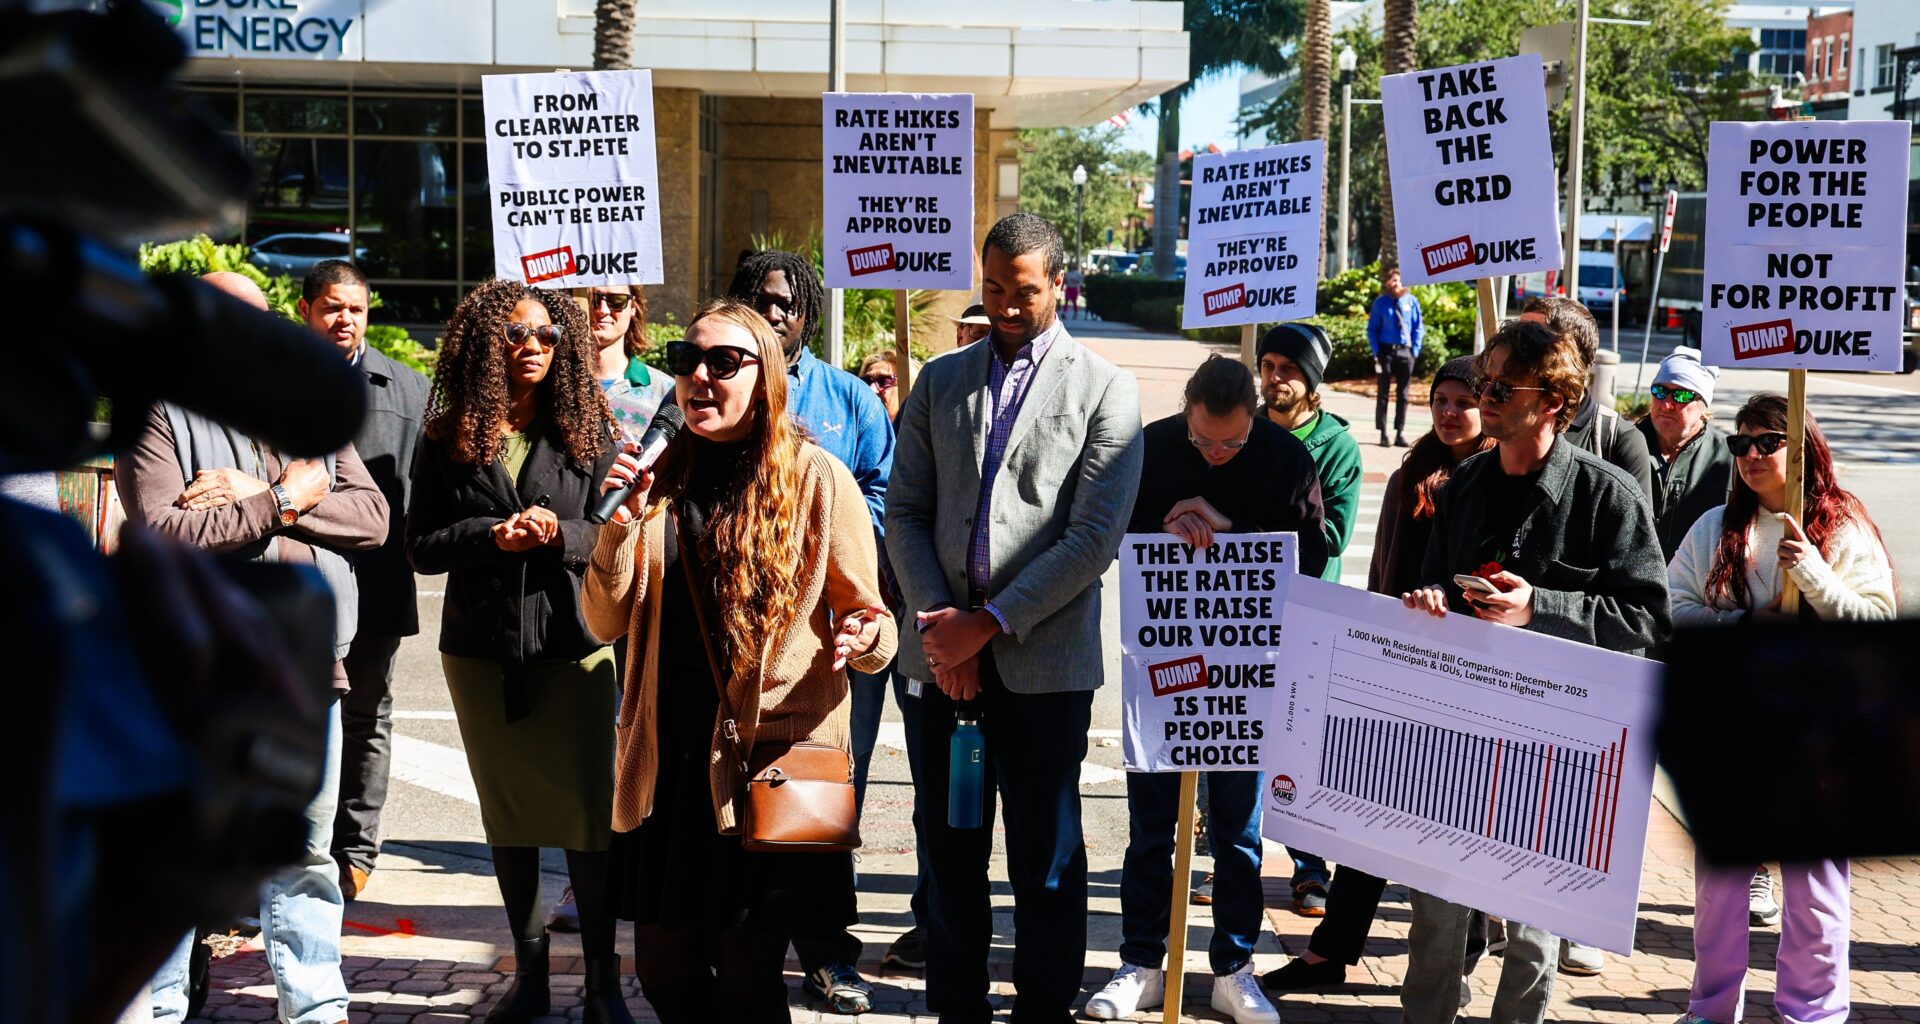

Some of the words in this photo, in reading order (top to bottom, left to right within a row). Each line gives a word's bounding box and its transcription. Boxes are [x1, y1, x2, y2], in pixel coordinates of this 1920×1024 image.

[195, 15, 353, 53] ENERGY
[1417, 66, 1496, 101] TAKE
[534, 93, 597, 112] FROM
[496, 115, 639, 136] CLEARWATER
[836, 109, 888, 128] RATE
[895, 110, 959, 128] HIKES
[1424, 98, 1507, 134] BACK
[514, 142, 541, 158] TO
[549, 138, 628, 157] ST.PETE
[859, 133, 936, 151] AREN'T
[1436, 133, 1493, 165] THE
[1750, 139, 1866, 164] POWER
[833, 155, 961, 174] INEVITABLE
[1203, 163, 1249, 183] RATE
[1254, 155, 1311, 177] HIKES
[1222, 178, 1290, 201] AREN'T
[1435, 175, 1511, 206] GRID
[1740, 171, 1800, 196] FOR
[1809, 171, 1867, 196] THE
[501, 189, 569, 207] PUBLIC
[575, 186, 645, 203] POWER
[859, 197, 937, 213] THEY'RE
[508, 210, 564, 226] CAN'T
[571, 208, 592, 223] BE
[598, 206, 644, 222] BEAT
[1198, 196, 1311, 224] INEVITABLE
[1748, 203, 1862, 228] PEOPLE
[846, 217, 951, 233] APPROVED
[1217, 237, 1287, 257] THEY'RE
[1427, 242, 1467, 268] DUMP
[1473, 238, 1535, 265] DUKE
[529, 254, 569, 277] DUMP
[576, 252, 637, 275] DUKE
[852, 249, 889, 270] DUMP
[894, 252, 951, 271] DUKE
[1205, 255, 1298, 277] APPROVED
[1768, 254, 1833, 278] NOT
[1208, 289, 1241, 310] DUMP
[1245, 286, 1296, 308] DUKE
[1711, 284, 1770, 309] FOR
[1779, 285, 1896, 311] PROFIT
[1738, 326, 1787, 352] DUMP
[1793, 330, 1871, 355] DUKE
[1133, 543, 1196, 565] THEY
[1205, 541, 1283, 564] RAISE
[1141, 570, 1188, 592] THE
[1196, 569, 1275, 591] RATES
[1146, 598, 1187, 619] WE
[1195, 597, 1272, 619] RAISE
[1138, 626, 1193, 647] OUR
[1199, 625, 1281, 647] VOICE
[1347, 628, 1370, 641] 1,000
[1371, 634, 1391, 647] kWh
[1393, 640, 1440, 660] Residential
[1441, 653, 1456, 664] Bill
[1457, 657, 1513, 680] Comparison:
[1515, 672, 1563, 691] December
[1564, 685, 1588, 698] 2025
[1382, 648, 1428, 668] Municipals
[1430, 660, 1437, 670] &
[1440, 662, 1463, 678] IOUs,
[1465, 670, 1496, 686] Lowest
[1498, 679, 1508, 688] to
[1510, 681, 1545, 698] Highest
[1155, 663, 1200, 688] DUMP
[1206, 664, 1275, 689] DUKE
[1174, 696, 1198, 716] IS
[1204, 696, 1246, 715] THE
[1165, 720, 1263, 741] PEOPLES
[1171, 745, 1259, 765] CHOICE
[1274, 779, 1292, 790] DUMP
[1274, 788, 1294, 801] DUKE
